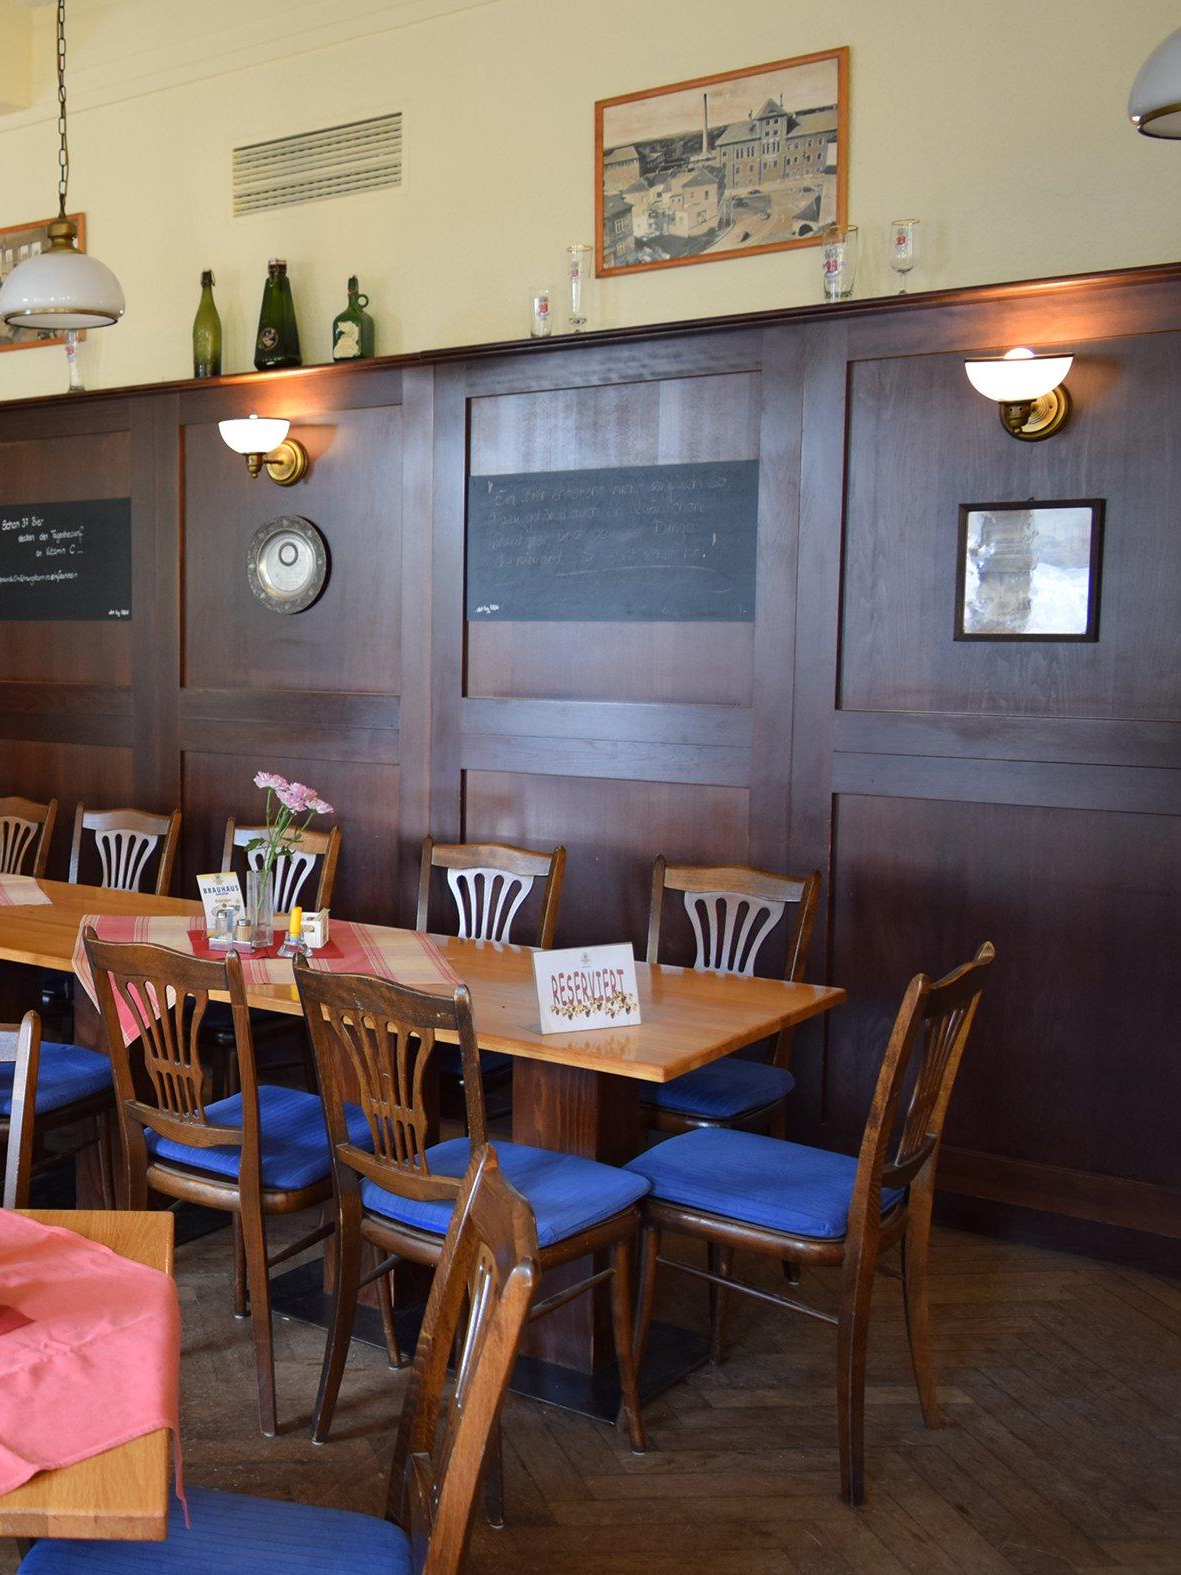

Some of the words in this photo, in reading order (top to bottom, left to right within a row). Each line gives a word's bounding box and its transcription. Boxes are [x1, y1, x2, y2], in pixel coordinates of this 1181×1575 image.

[1, 519, 20, 531] Schon
[69, 543, 76, 555] C
[202, 885, 239, 895] BRAUHAUS
[550, 967, 624, 1007] RESERVIERT
